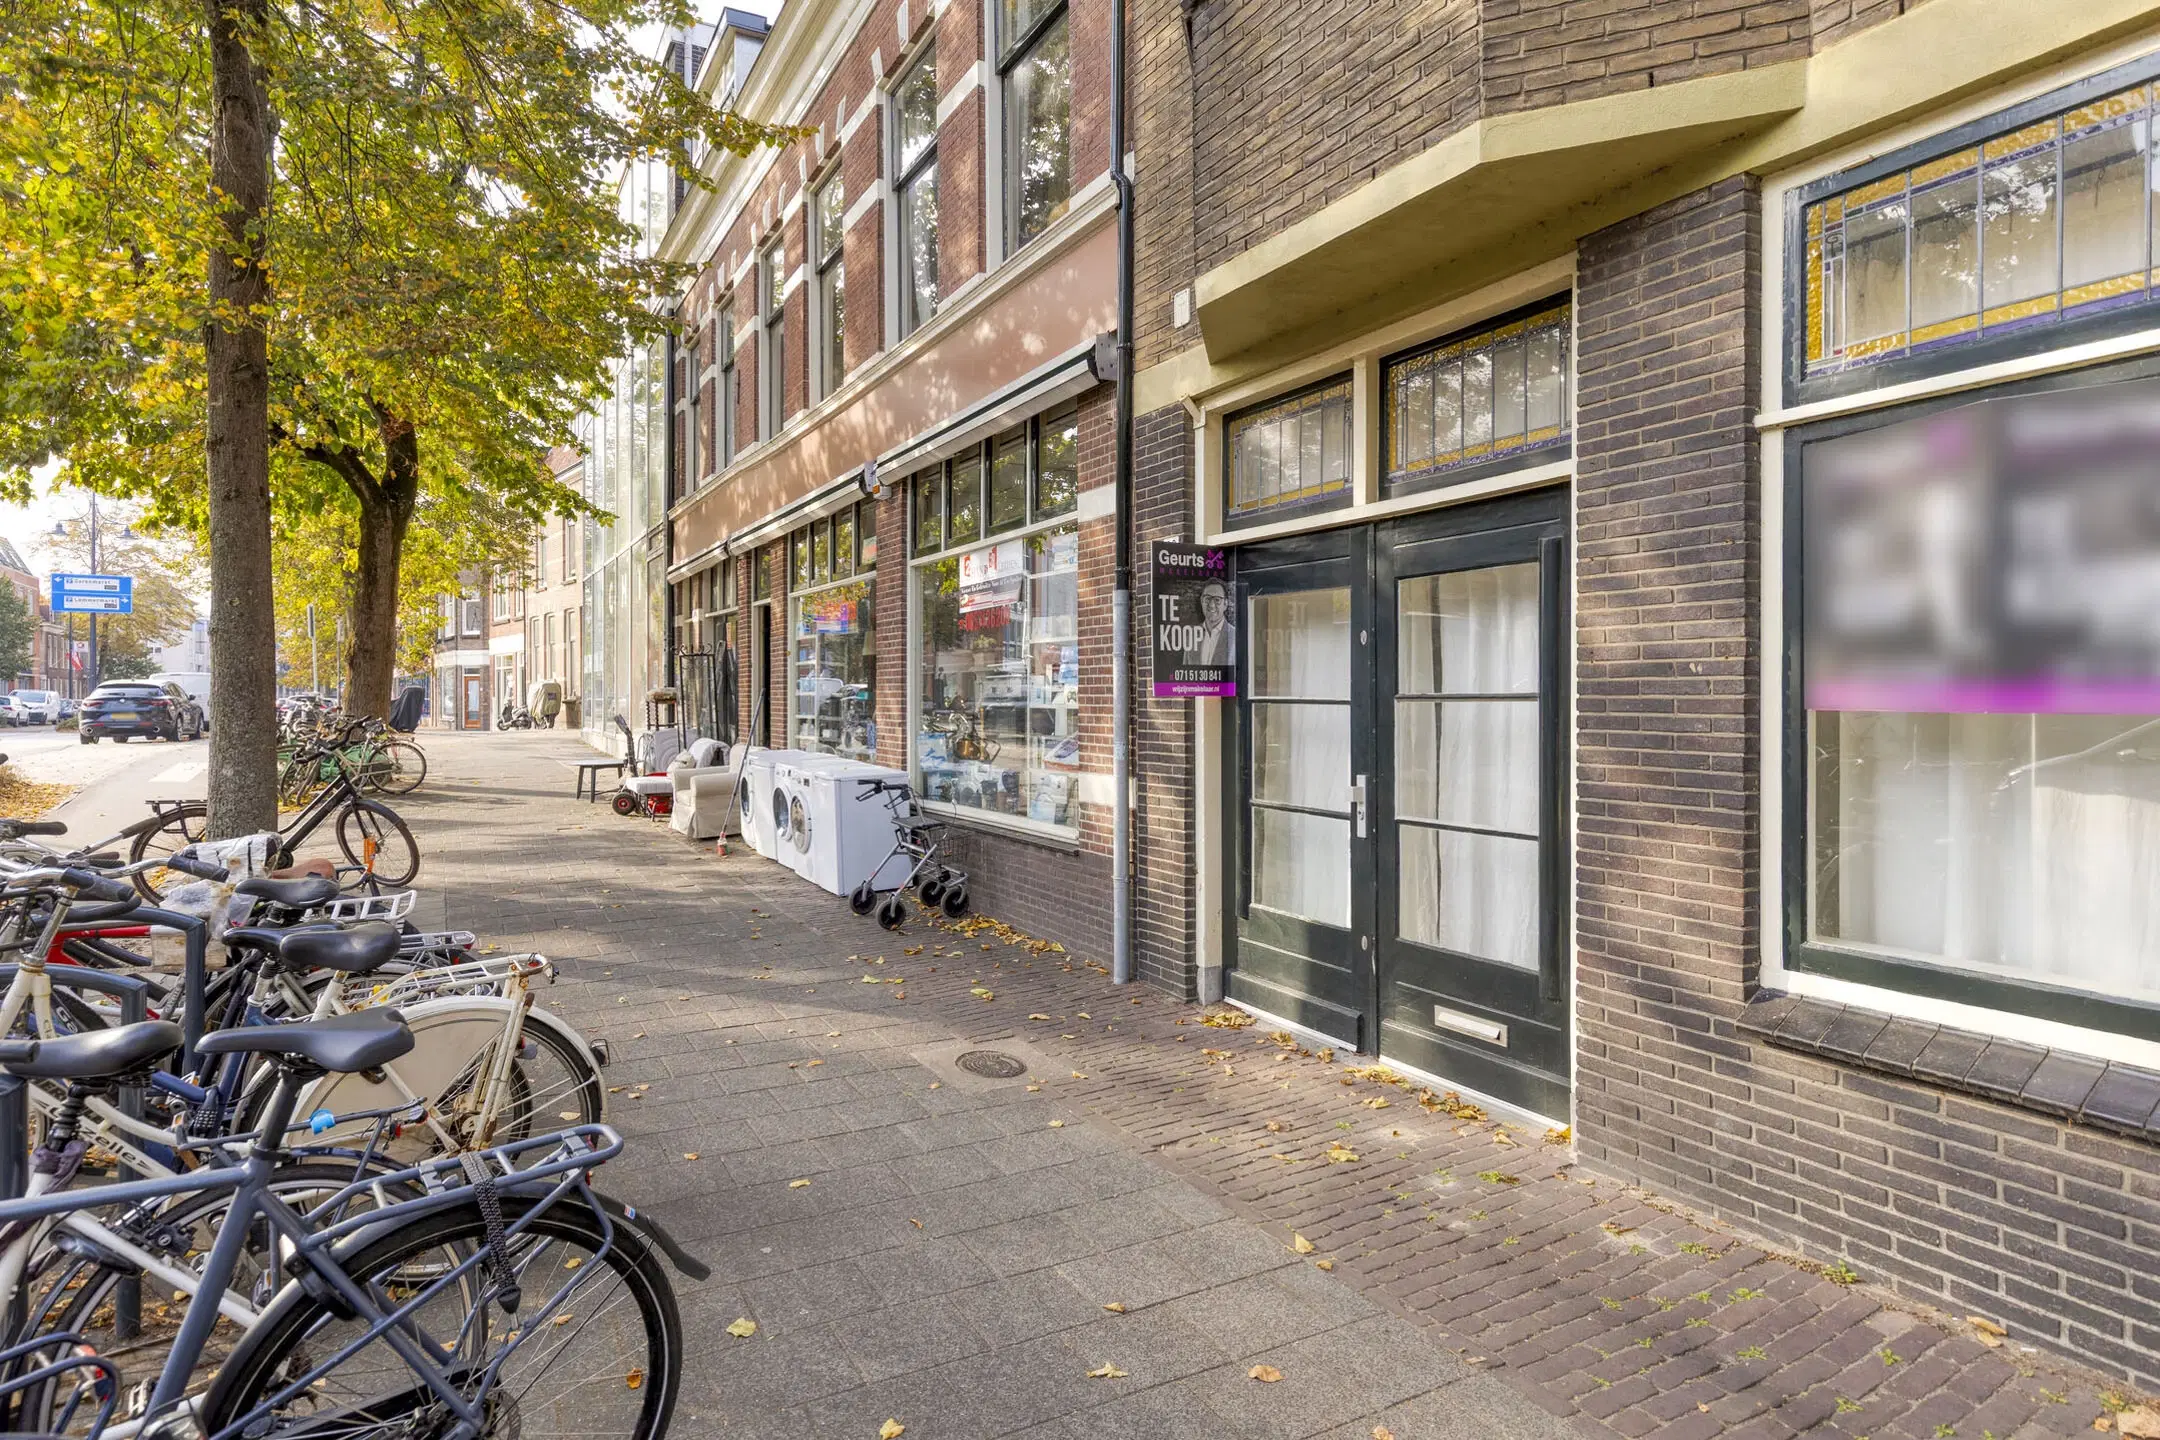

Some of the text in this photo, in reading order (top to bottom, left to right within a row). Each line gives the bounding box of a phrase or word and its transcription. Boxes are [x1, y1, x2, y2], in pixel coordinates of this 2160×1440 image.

[1158, 549, 1205, 568] Geurts
[1158, 594, 1180, 622] TE
[1159, 624, 1204, 652] KOOP
